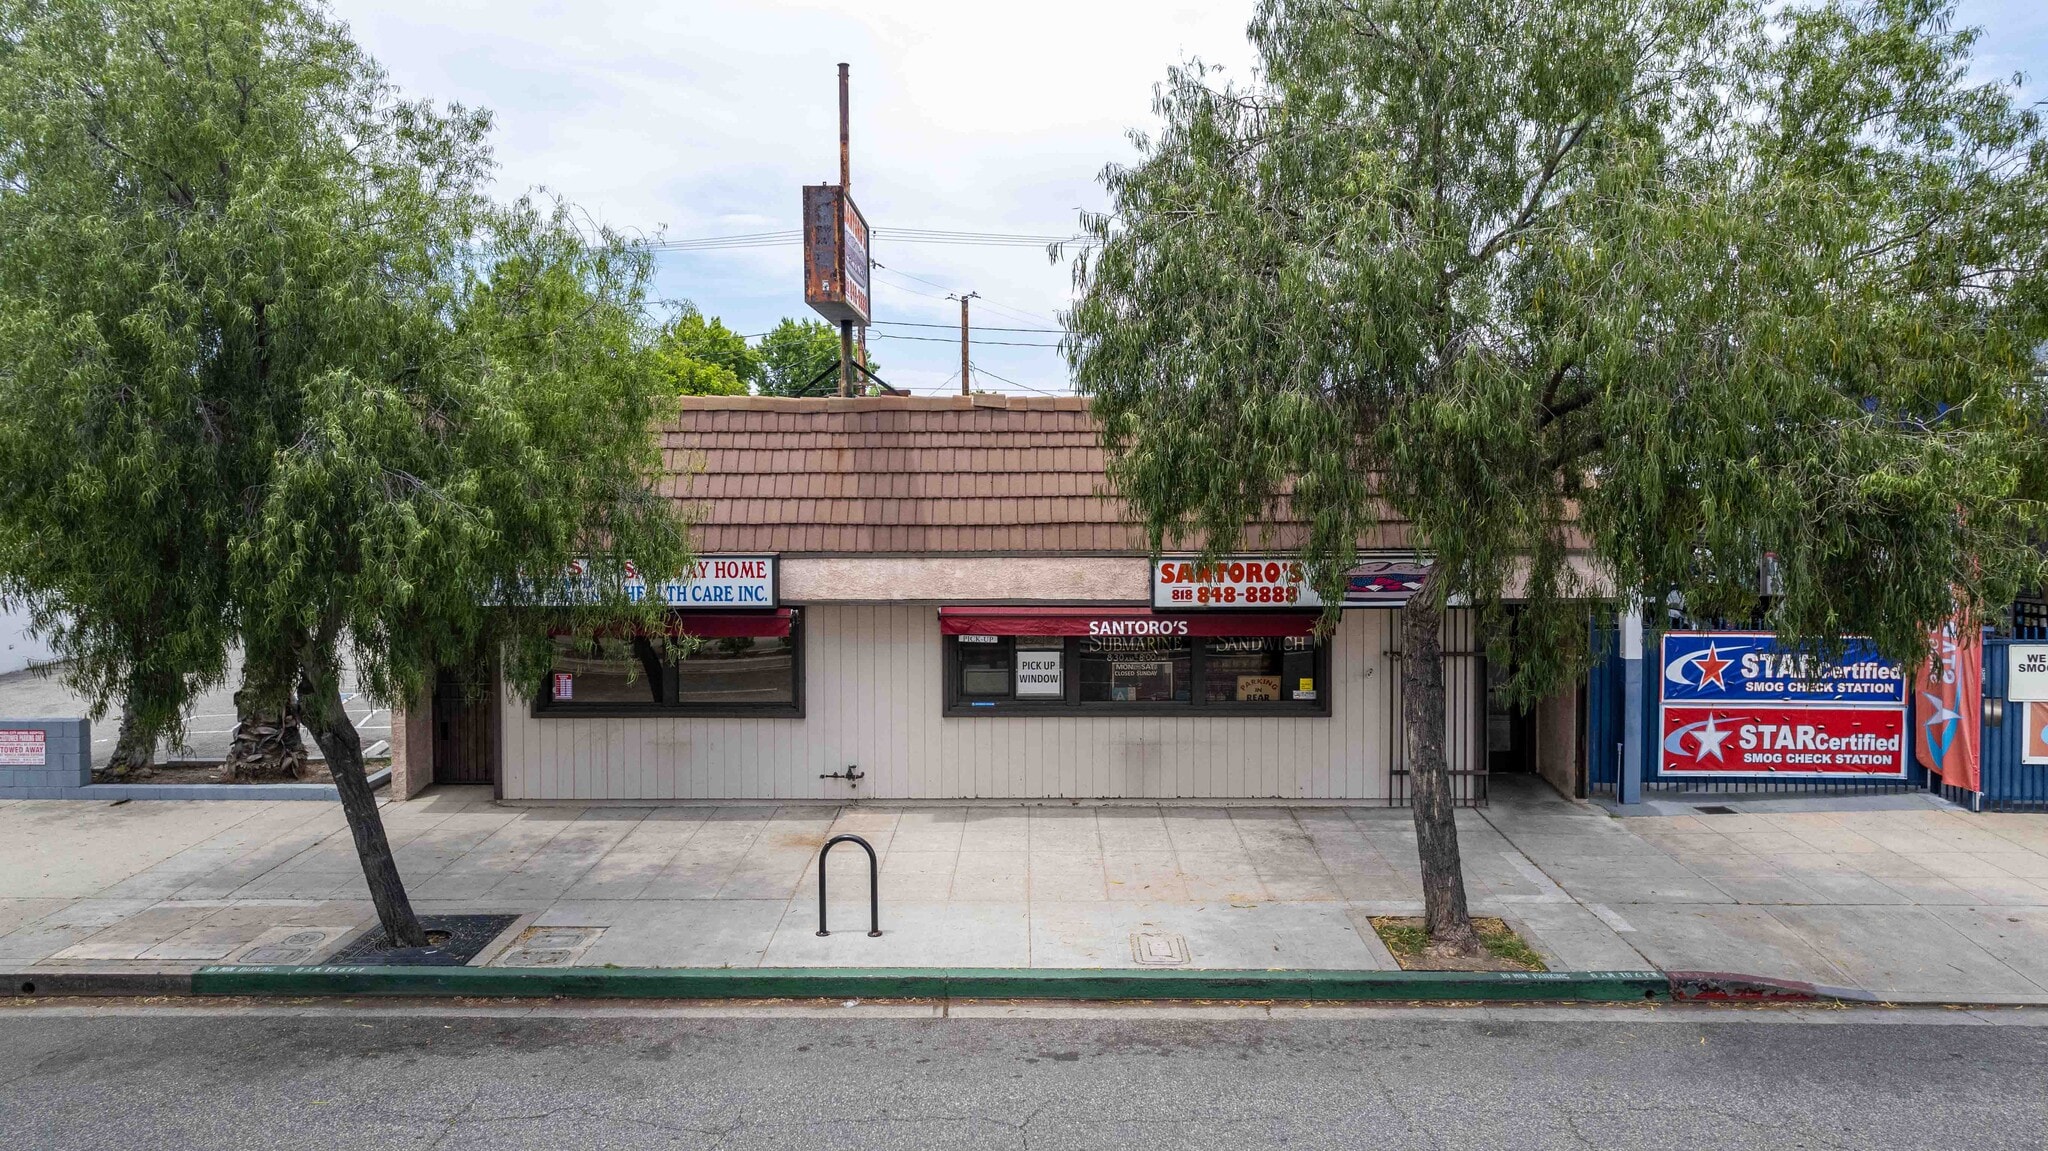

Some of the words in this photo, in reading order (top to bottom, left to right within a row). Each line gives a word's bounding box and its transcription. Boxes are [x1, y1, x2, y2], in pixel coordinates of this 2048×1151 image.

[715, 561, 767, 579] HOME
[1160, 562, 1303, 584] SANTORO'S
[624, 585, 687, 602] HETH
[691, 585, 733, 602] CARE
[738, 586, 768, 602] INC.
[1172, 589, 1193, 600] 818
[1197, 586, 1297, 603] 848-8888
[1089, 620, 1188, 635] SANTORO'S
[1089, 635, 1183, 653] SUBMARINE
[1216, 635, 1305, 652] SANDWICH
[1022, 661, 1042, 670] PICK
[1044, 661, 1056, 670] UP
[2027, 654, 2047, 663] WE
[2018, 663, 2048, 673] SMO
[1019, 674, 1059, 683] WINDOW
[1240, 678, 1279, 691] PARKING
[1745, 682, 1784, 692] SMOG
[1788, 682, 1833, 693] CHECK
[1837, 683, 1895, 693] STATION
[1744, 753, 1782, 763] SMOG
[1786, 753, 1832, 764] CHECK
[1835, 754, 1892, 765] STATION
